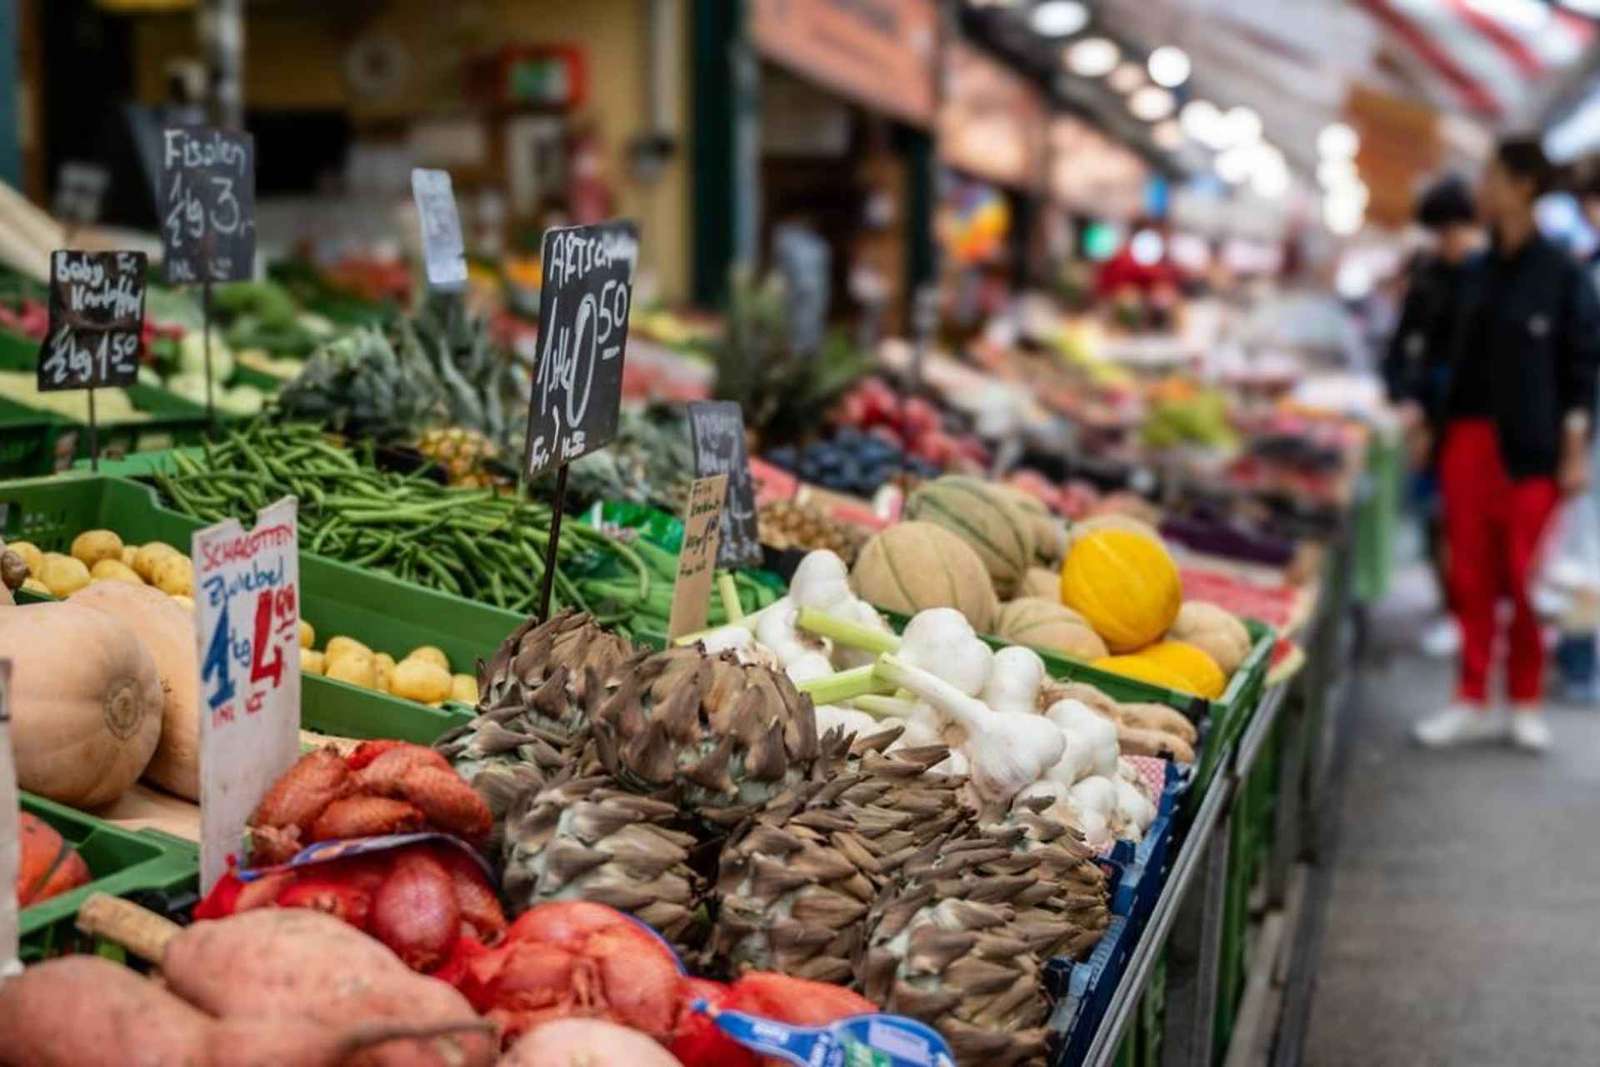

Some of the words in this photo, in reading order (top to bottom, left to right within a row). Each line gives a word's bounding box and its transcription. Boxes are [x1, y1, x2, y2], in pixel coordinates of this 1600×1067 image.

[55, 251, 104, 288] Baby
[201, 524, 294, 572] SCHALOTTEN
[203, 555, 285, 607] Zwiebel
